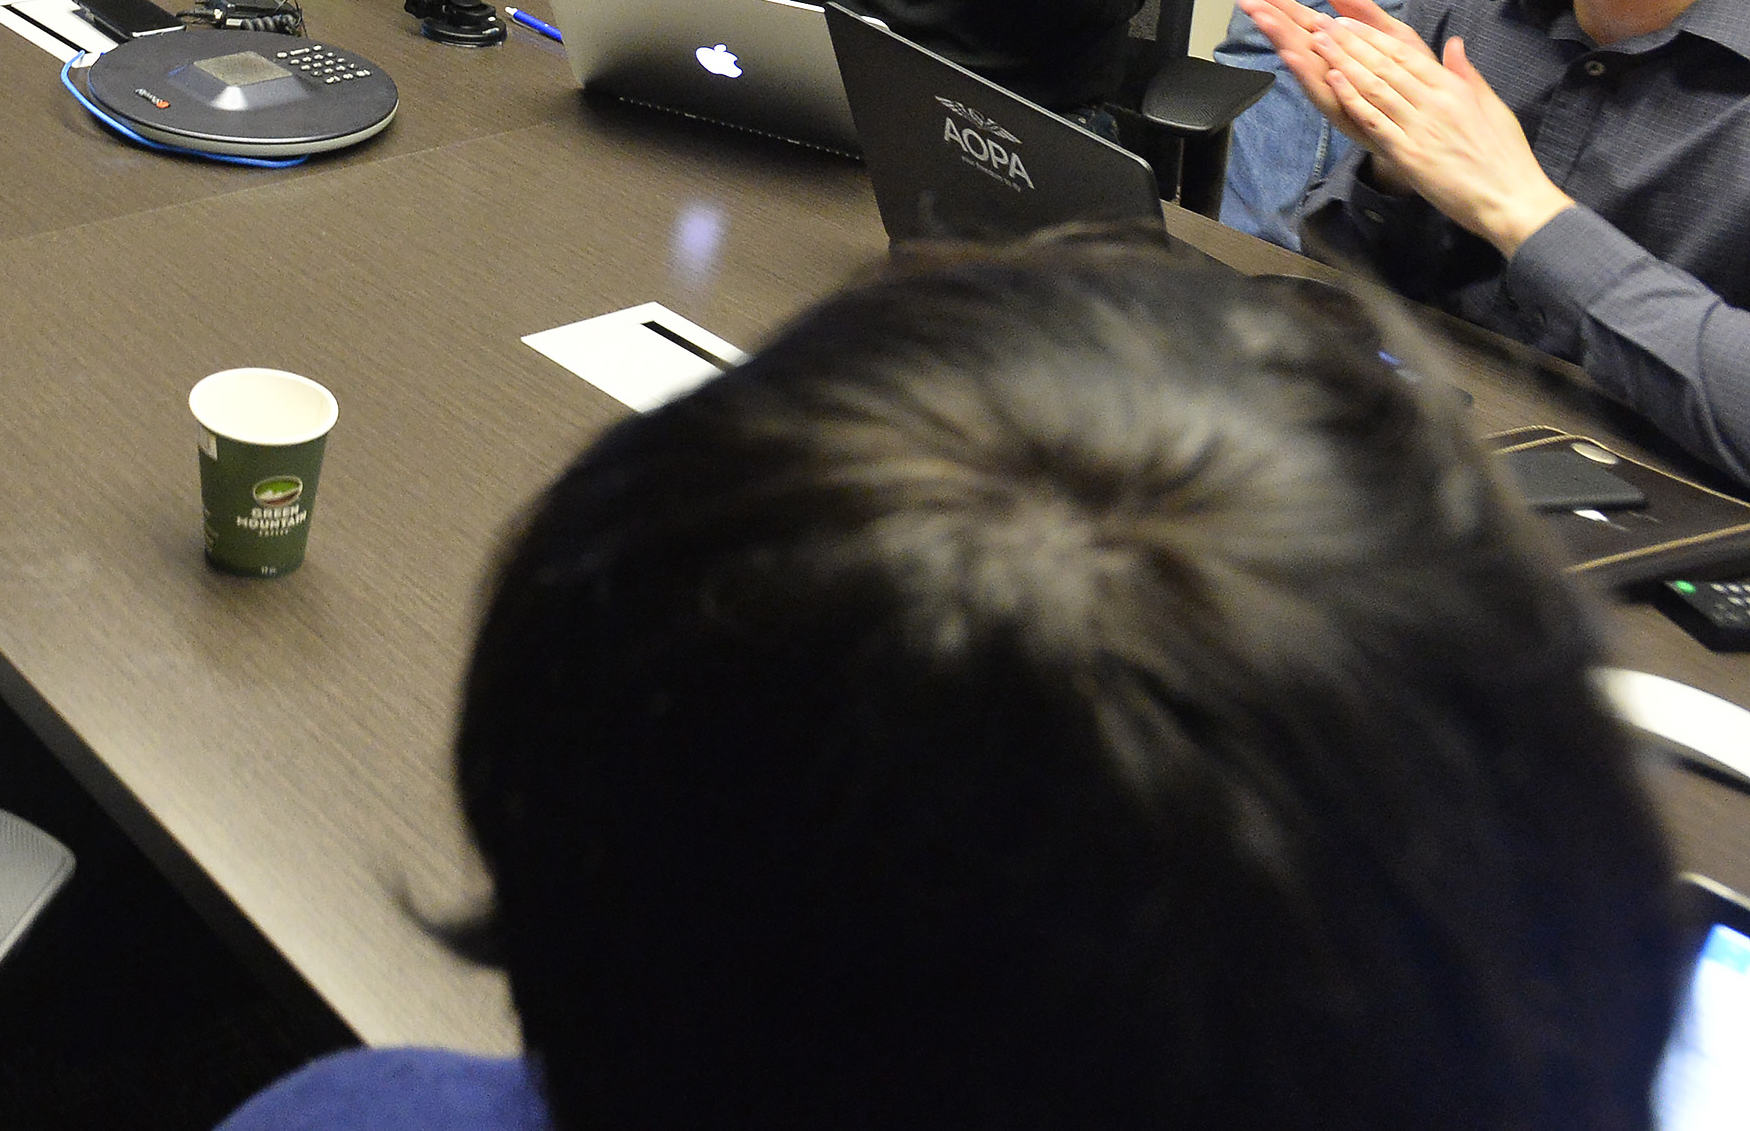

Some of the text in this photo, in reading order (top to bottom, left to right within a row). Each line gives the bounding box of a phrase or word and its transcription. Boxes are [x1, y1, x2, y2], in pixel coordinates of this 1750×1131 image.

[944, 116, 1035, 189] AOPA
[236, 510, 307, 530] MOUNTAIN
[251, 504, 299, 520] GREEN
